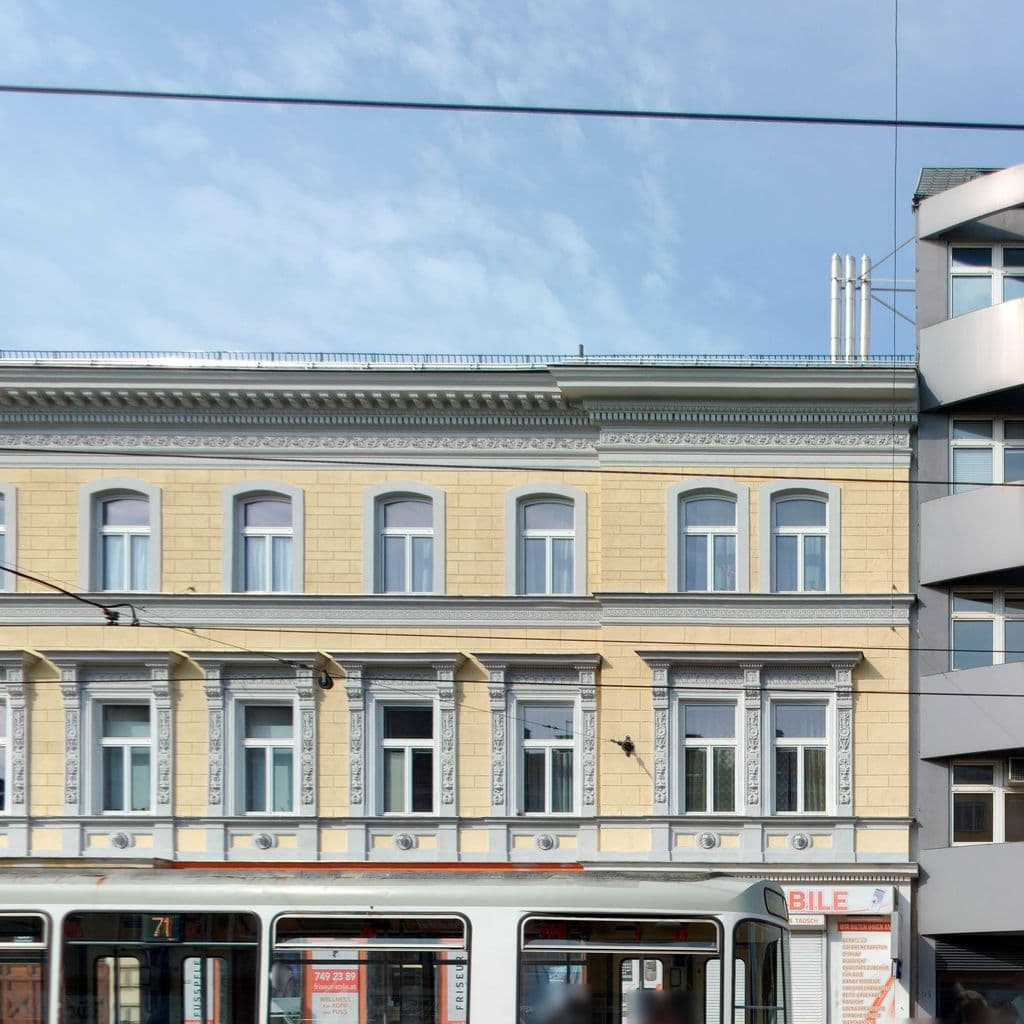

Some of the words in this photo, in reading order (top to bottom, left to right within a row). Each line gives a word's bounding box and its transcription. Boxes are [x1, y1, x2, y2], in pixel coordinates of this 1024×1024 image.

[789, 890, 848, 911] BILE
[152, 917, 172, 936] 71
[314, 971, 331, 981] 749
[345, 971, 356, 981] 89
[456, 956, 464, 1010] FRISEUR
